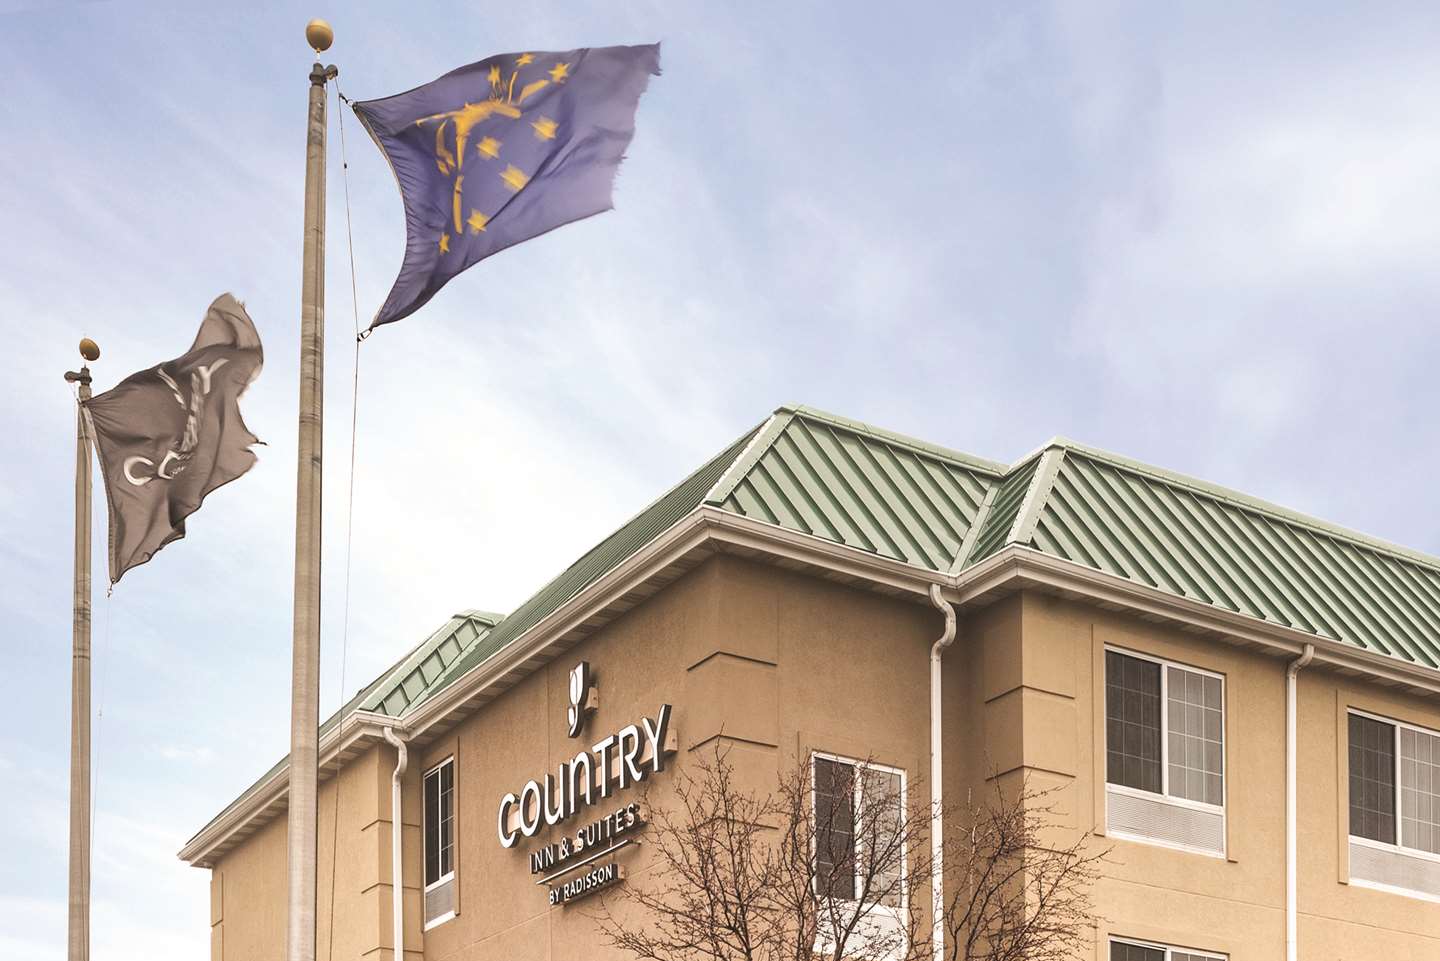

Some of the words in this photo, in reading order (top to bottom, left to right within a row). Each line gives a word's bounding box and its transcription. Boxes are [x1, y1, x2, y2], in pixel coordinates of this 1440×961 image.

[498, 703, 672, 849] COUNTRY
[529, 845, 556, 875] INN
[557, 837, 571, 861] &
[576, 803, 640, 850] SUITES
[549, 887, 562, 905] BY
[563, 863, 618, 902] RADISSON
